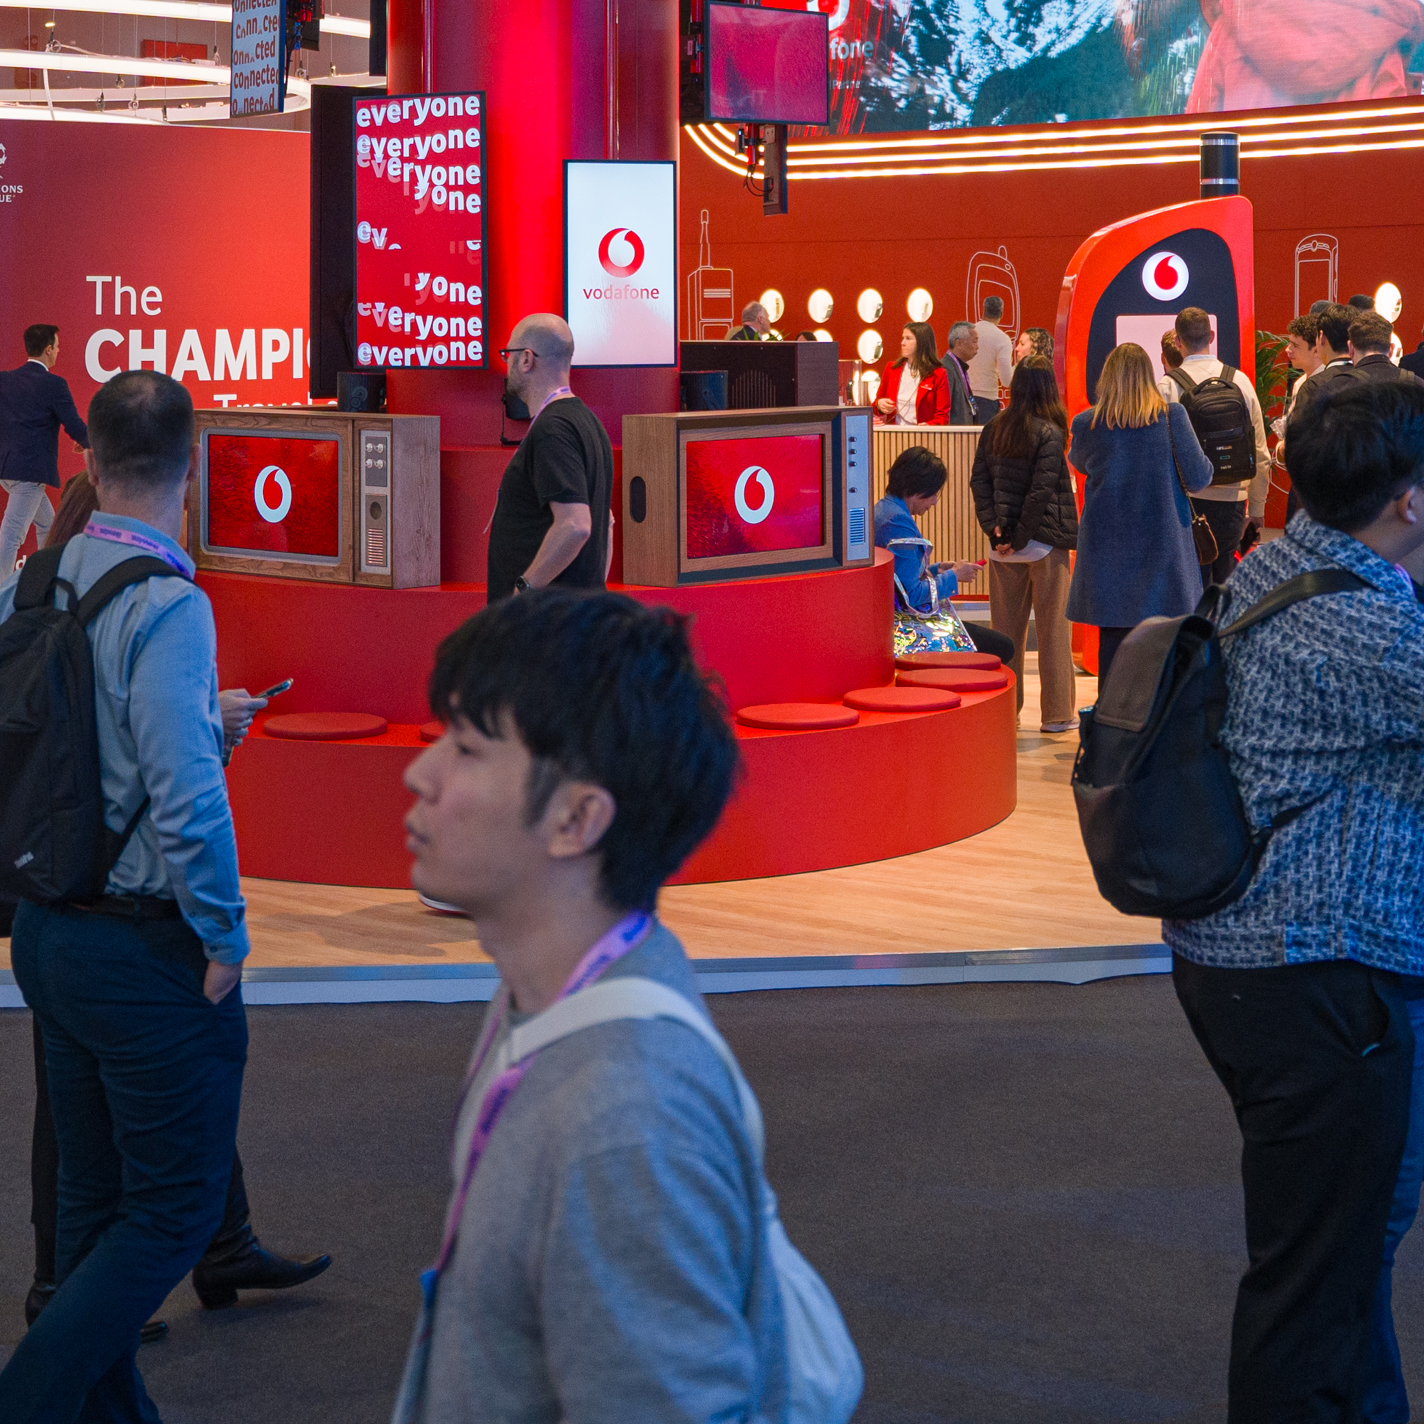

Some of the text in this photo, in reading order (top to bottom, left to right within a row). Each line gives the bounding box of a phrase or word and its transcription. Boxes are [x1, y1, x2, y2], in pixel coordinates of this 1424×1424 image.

[356, 95, 480, 127] everyone
[356, 127, 481, 160] everyone
[86, 275, 163, 316] The
[582, 284, 660, 300] vodafone
[84, 328, 311, 384] CHAMPI
